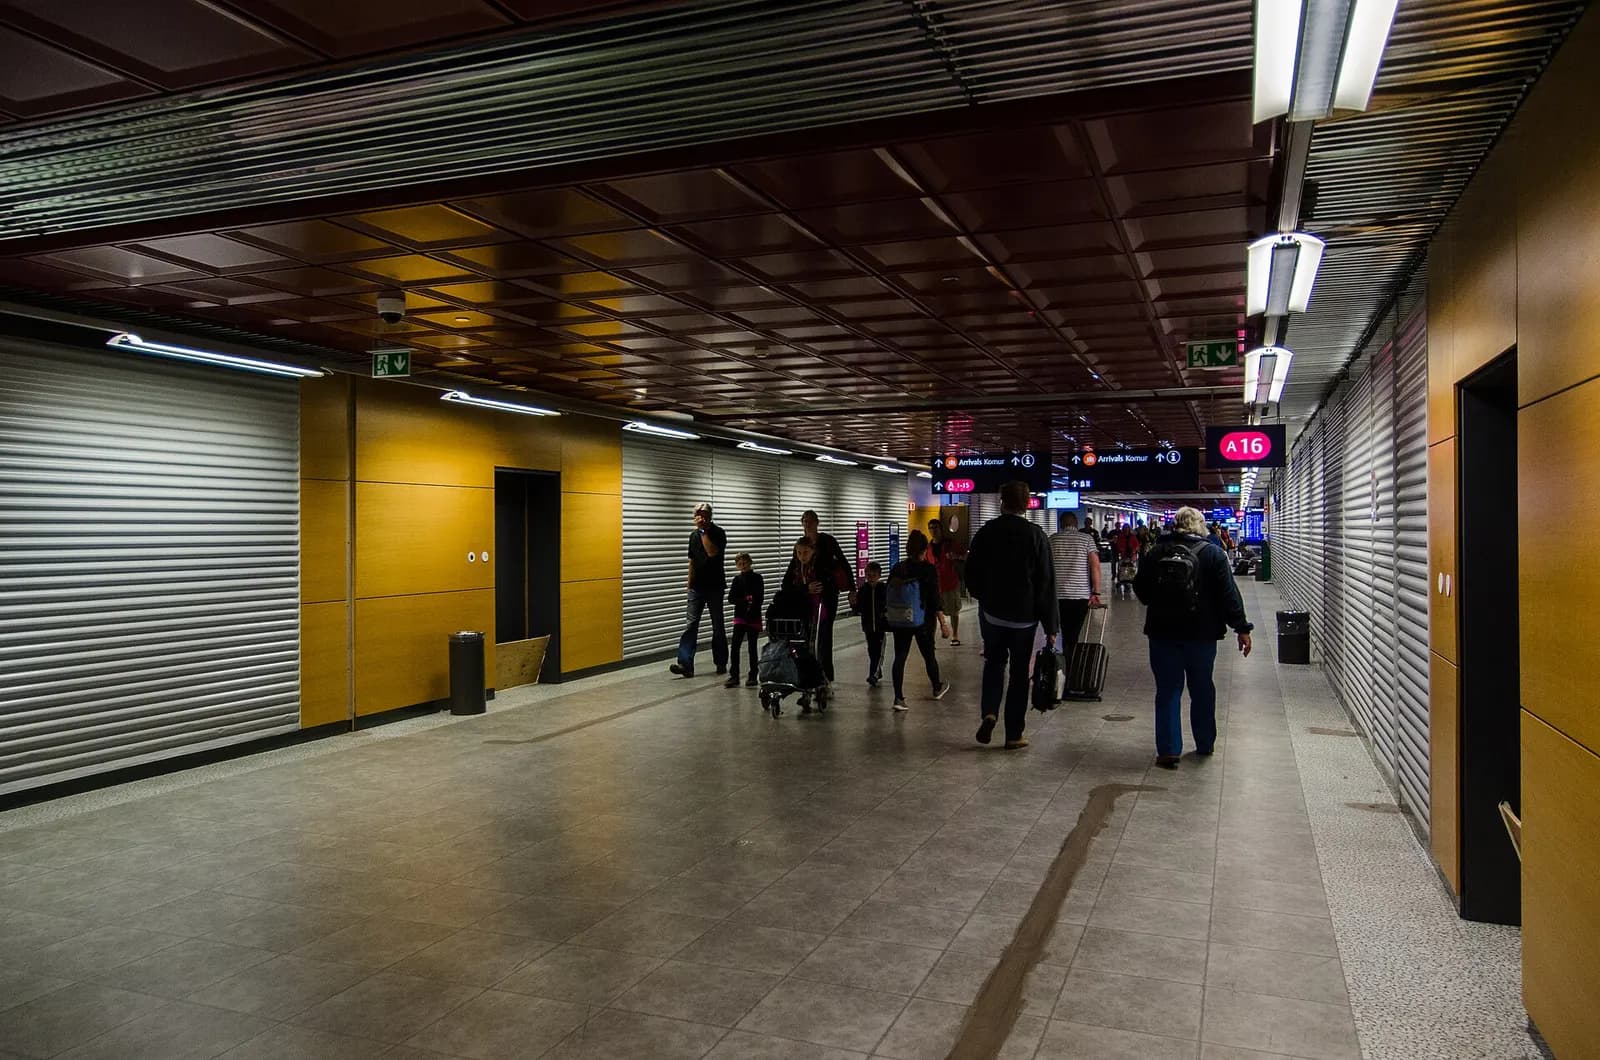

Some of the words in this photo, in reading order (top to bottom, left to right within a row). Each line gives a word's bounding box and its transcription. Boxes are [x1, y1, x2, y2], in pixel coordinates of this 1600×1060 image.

[1226, 441, 1237, 452] A
[1240, 438, 1263, 454] 16
[958, 458, 982, 466] Arrivals
[983, 458, 1005, 466] Komur
